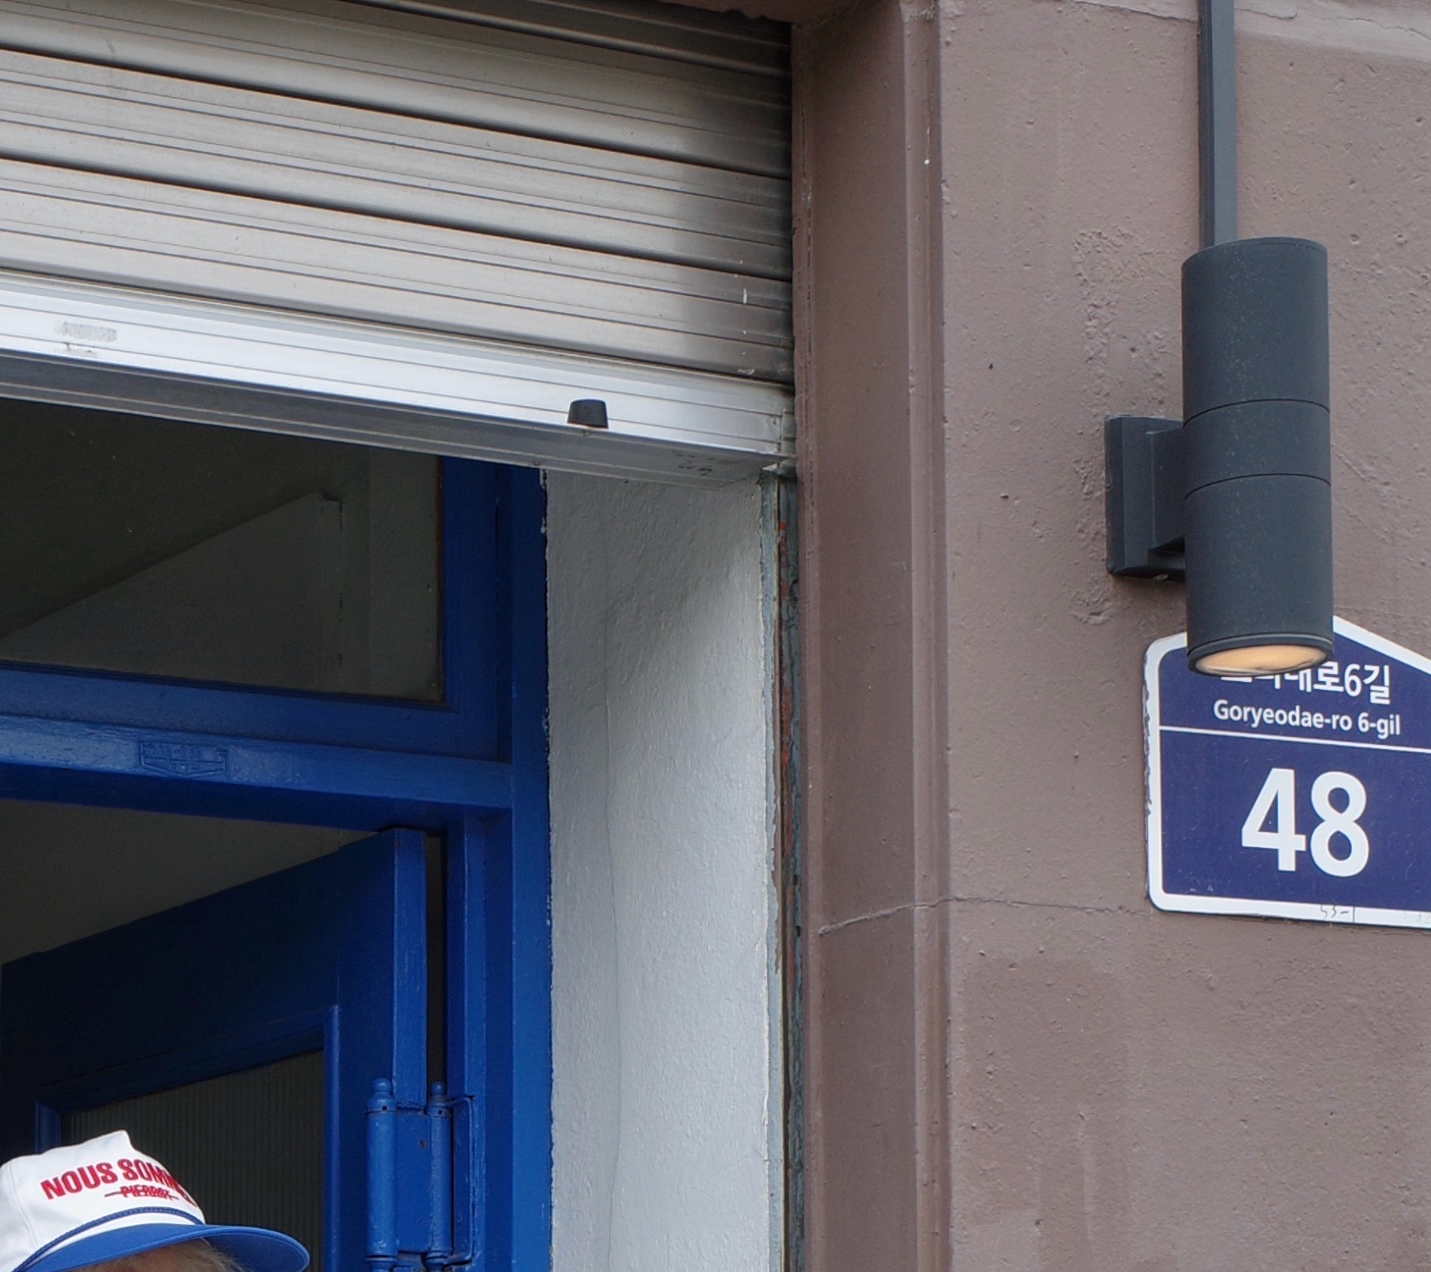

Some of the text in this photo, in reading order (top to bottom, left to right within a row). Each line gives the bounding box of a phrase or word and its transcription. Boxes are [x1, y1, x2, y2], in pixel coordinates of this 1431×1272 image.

[1213, 699, 1401, 740] Goryeodae-ro 6-gil
[1241, 767, 1369, 877] 48
[40, 1162, 119, 1200] NOUS
